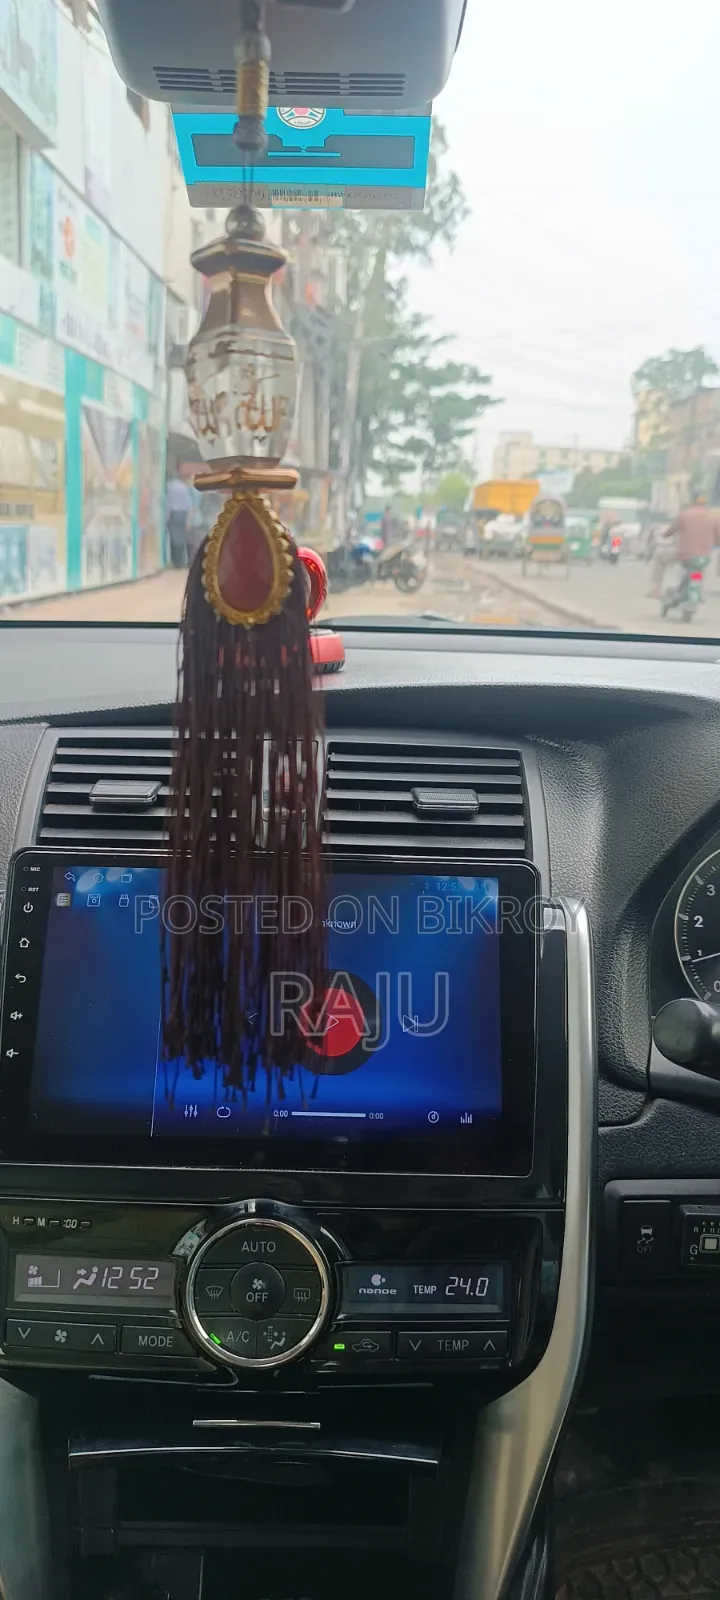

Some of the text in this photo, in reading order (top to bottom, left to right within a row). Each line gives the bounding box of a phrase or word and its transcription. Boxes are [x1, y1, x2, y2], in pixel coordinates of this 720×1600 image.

[706, 884, 716, 896] 3
[320, 918, 357, 929] nknown
[694, 915, 704, 928] 2
[696, 949, 703, 957] 1
[12, 1216, 20, 1225] H
[37, 1218, 46, 1227] M
[241, 1241, 277, 1254] AUTO
[358, 1287, 398, 1296] nanoe
[413, 1276, 490, 1297] TEMP 24.0
[246, 1291, 269, 1303] OFF
[138, 1335, 174, 1348] MODE
[225, 1330, 251, 1344] A/C
[437, 1339, 470, 1351] TEMP
